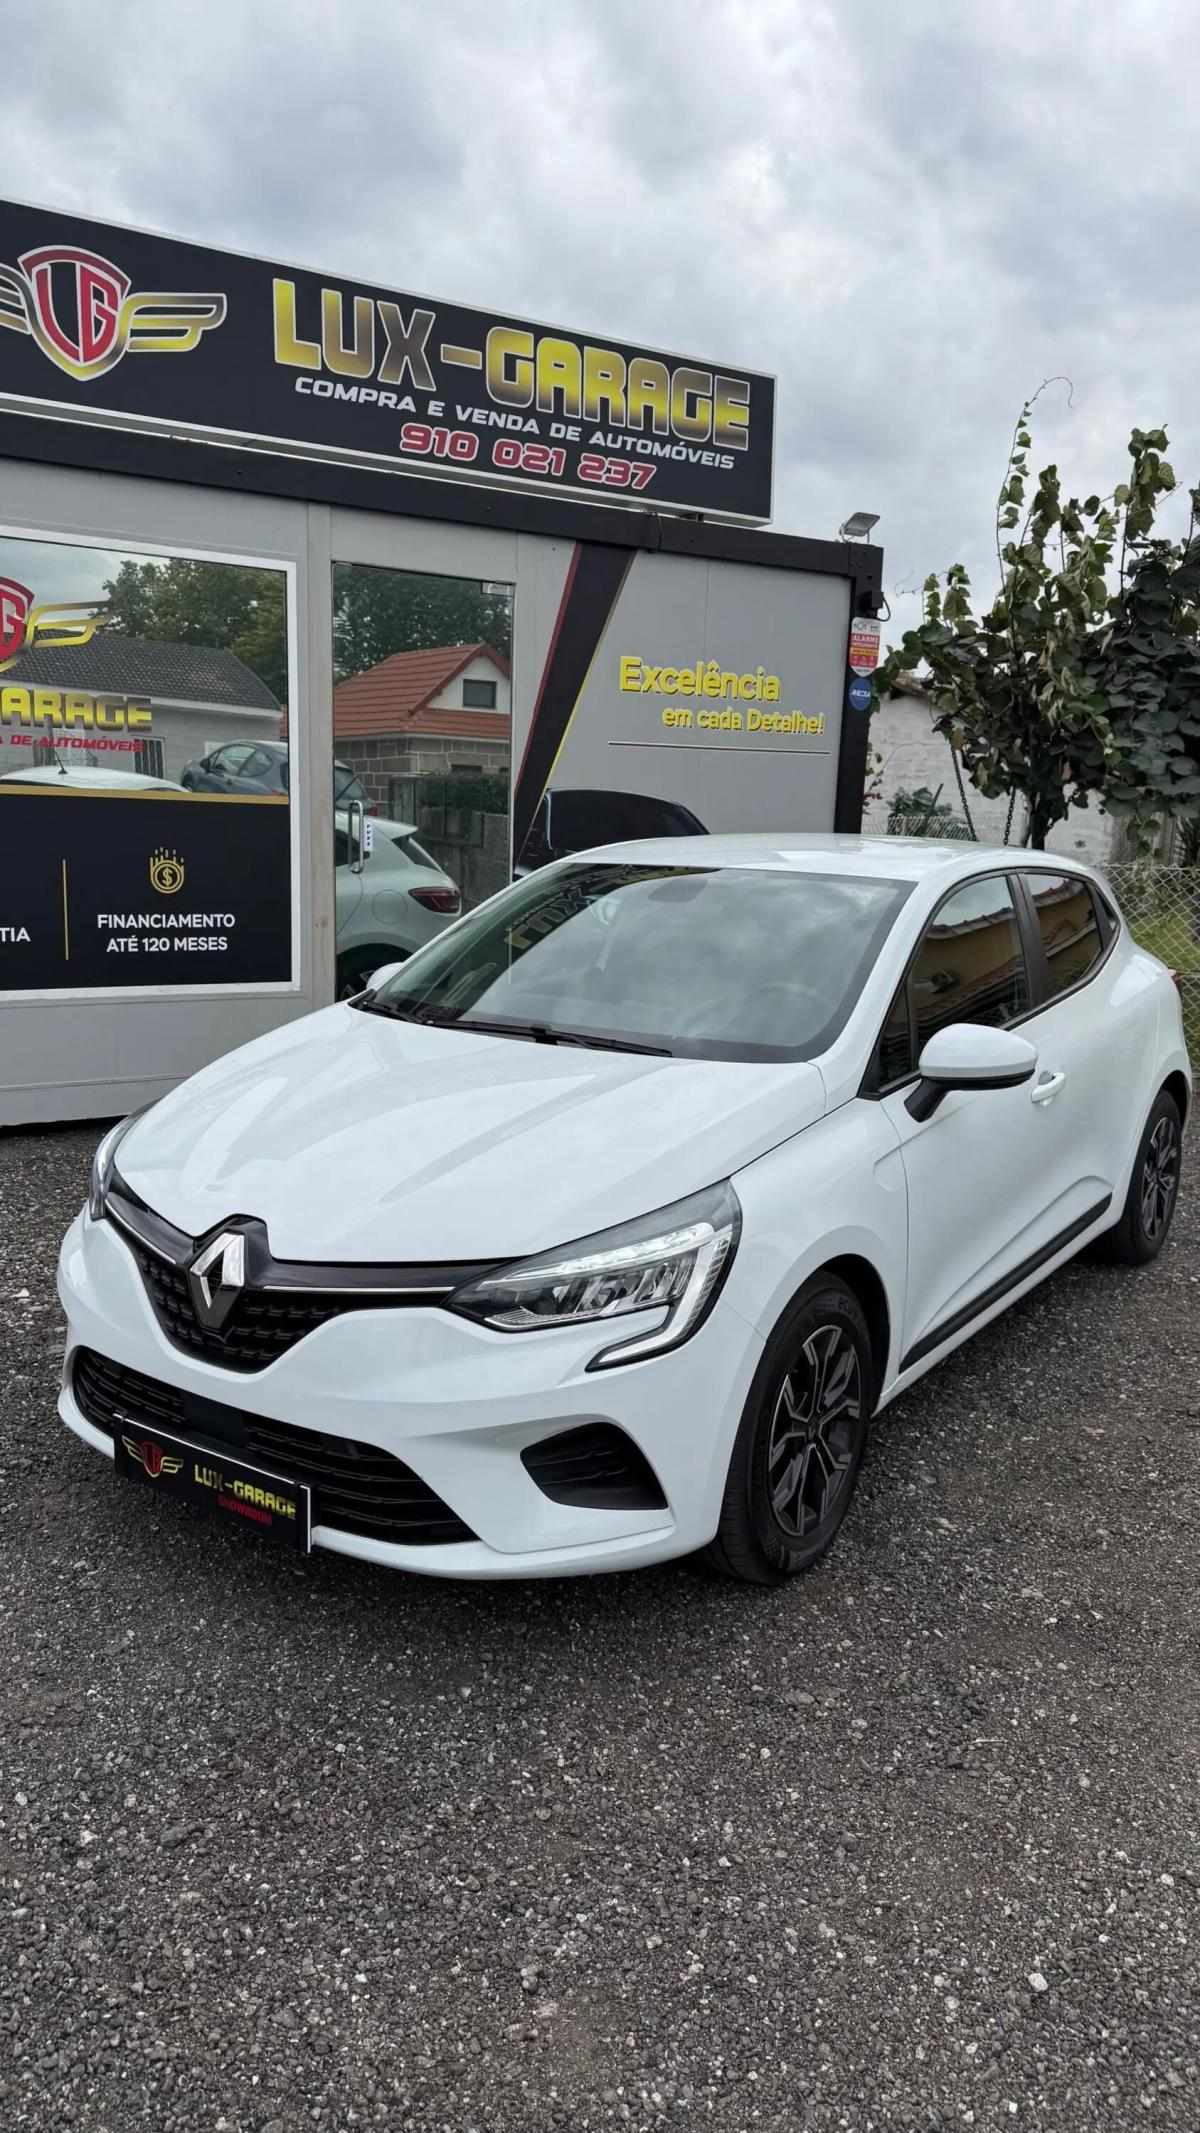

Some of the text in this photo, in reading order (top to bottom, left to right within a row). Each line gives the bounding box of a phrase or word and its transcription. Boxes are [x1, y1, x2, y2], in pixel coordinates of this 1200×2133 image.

[272, 277, 751, 452] LUX-GARAGE
[295, 376, 735, 470] COMPRA E VENDA DE AUTOMÓVEIS
[400, 422, 657, 490] 910 021 237
[619, 655, 781, 702] Excelência
[10, 735, 33, 746] DE
[38, 735, 145, 753] AUTOMÓVEIS
[662, 706, 825, 736] em cada Detalhe!
[97, 914, 236, 929] FINANCIAMENTO
[106, 935, 228, 952] ATÉ 120 MESES
[194, 1463, 297, 1520] LUX-GARAGE
